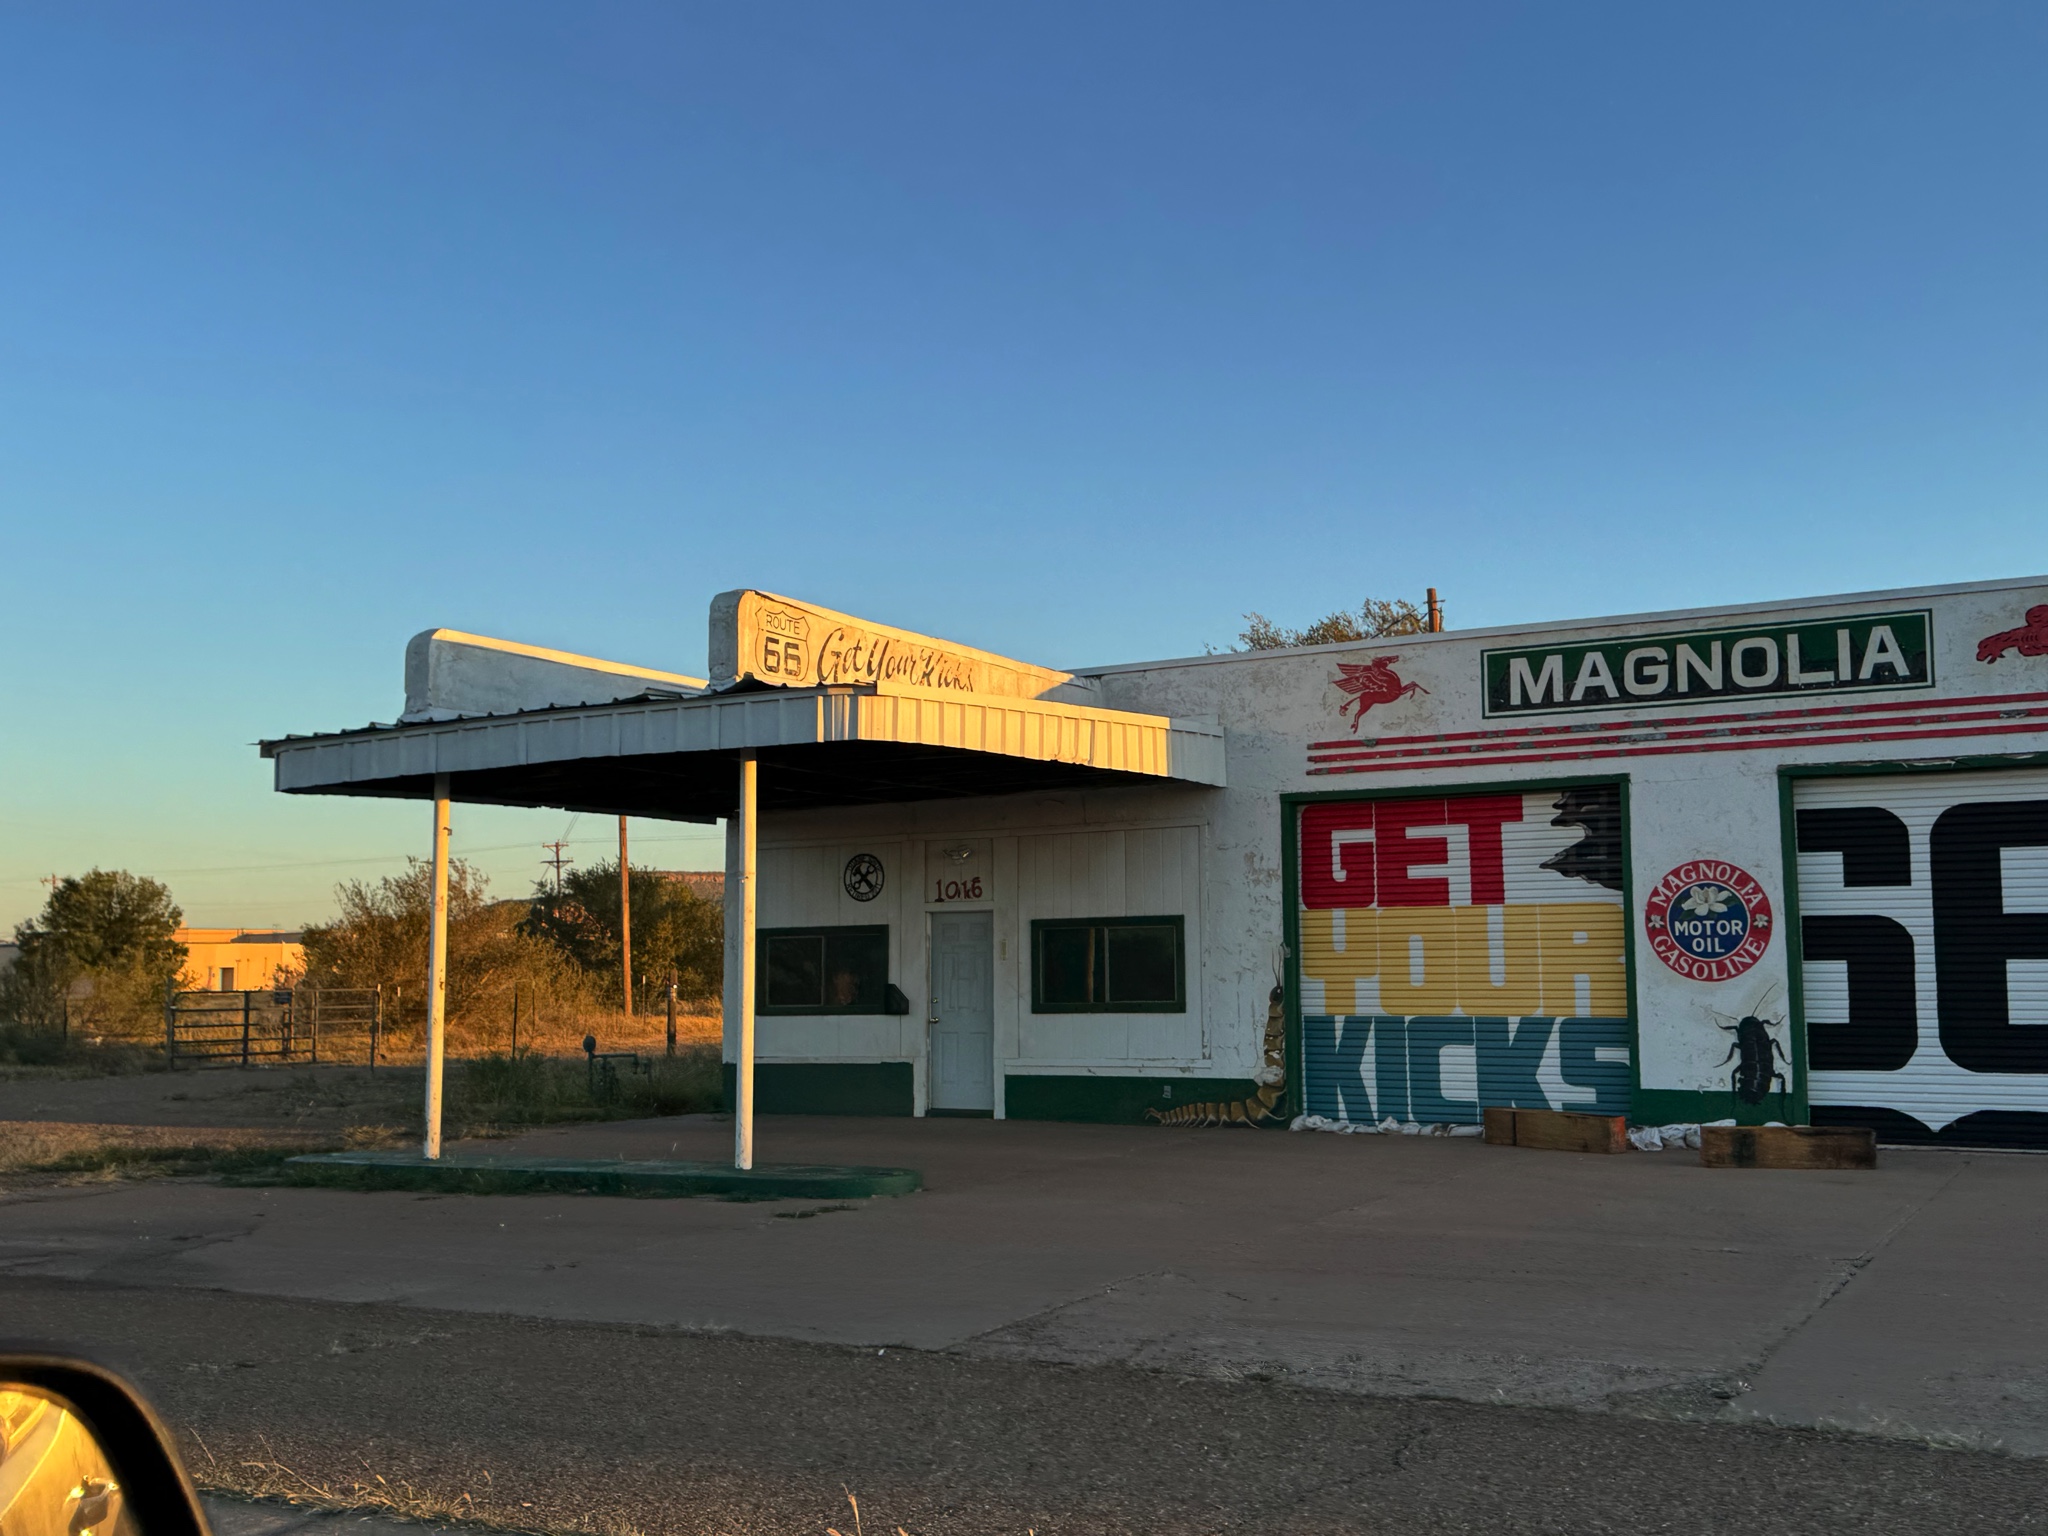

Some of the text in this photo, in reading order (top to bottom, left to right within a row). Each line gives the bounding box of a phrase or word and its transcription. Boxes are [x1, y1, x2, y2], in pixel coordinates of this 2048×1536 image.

[766, 614, 800, 635] ROUTE
[764, 636, 801, 677] 66
[816, 627, 974, 693] Get Your Kicks
[1508, 624, 1910, 706] MAGNOLIA
[1301, 794, 1524, 910] GET
[934, 876, 983, 902] 1016
[1650, 862, 1764, 910] MAGNOLIA
[1674, 919, 1744, 937] MOTOR
[1691, 937, 1725, 953] OIL
[1301, 903, 1628, 1018] YOUR
[1653, 935, 1766, 980] GASOLINE
[1303, 1016, 1632, 1127] KICKS
